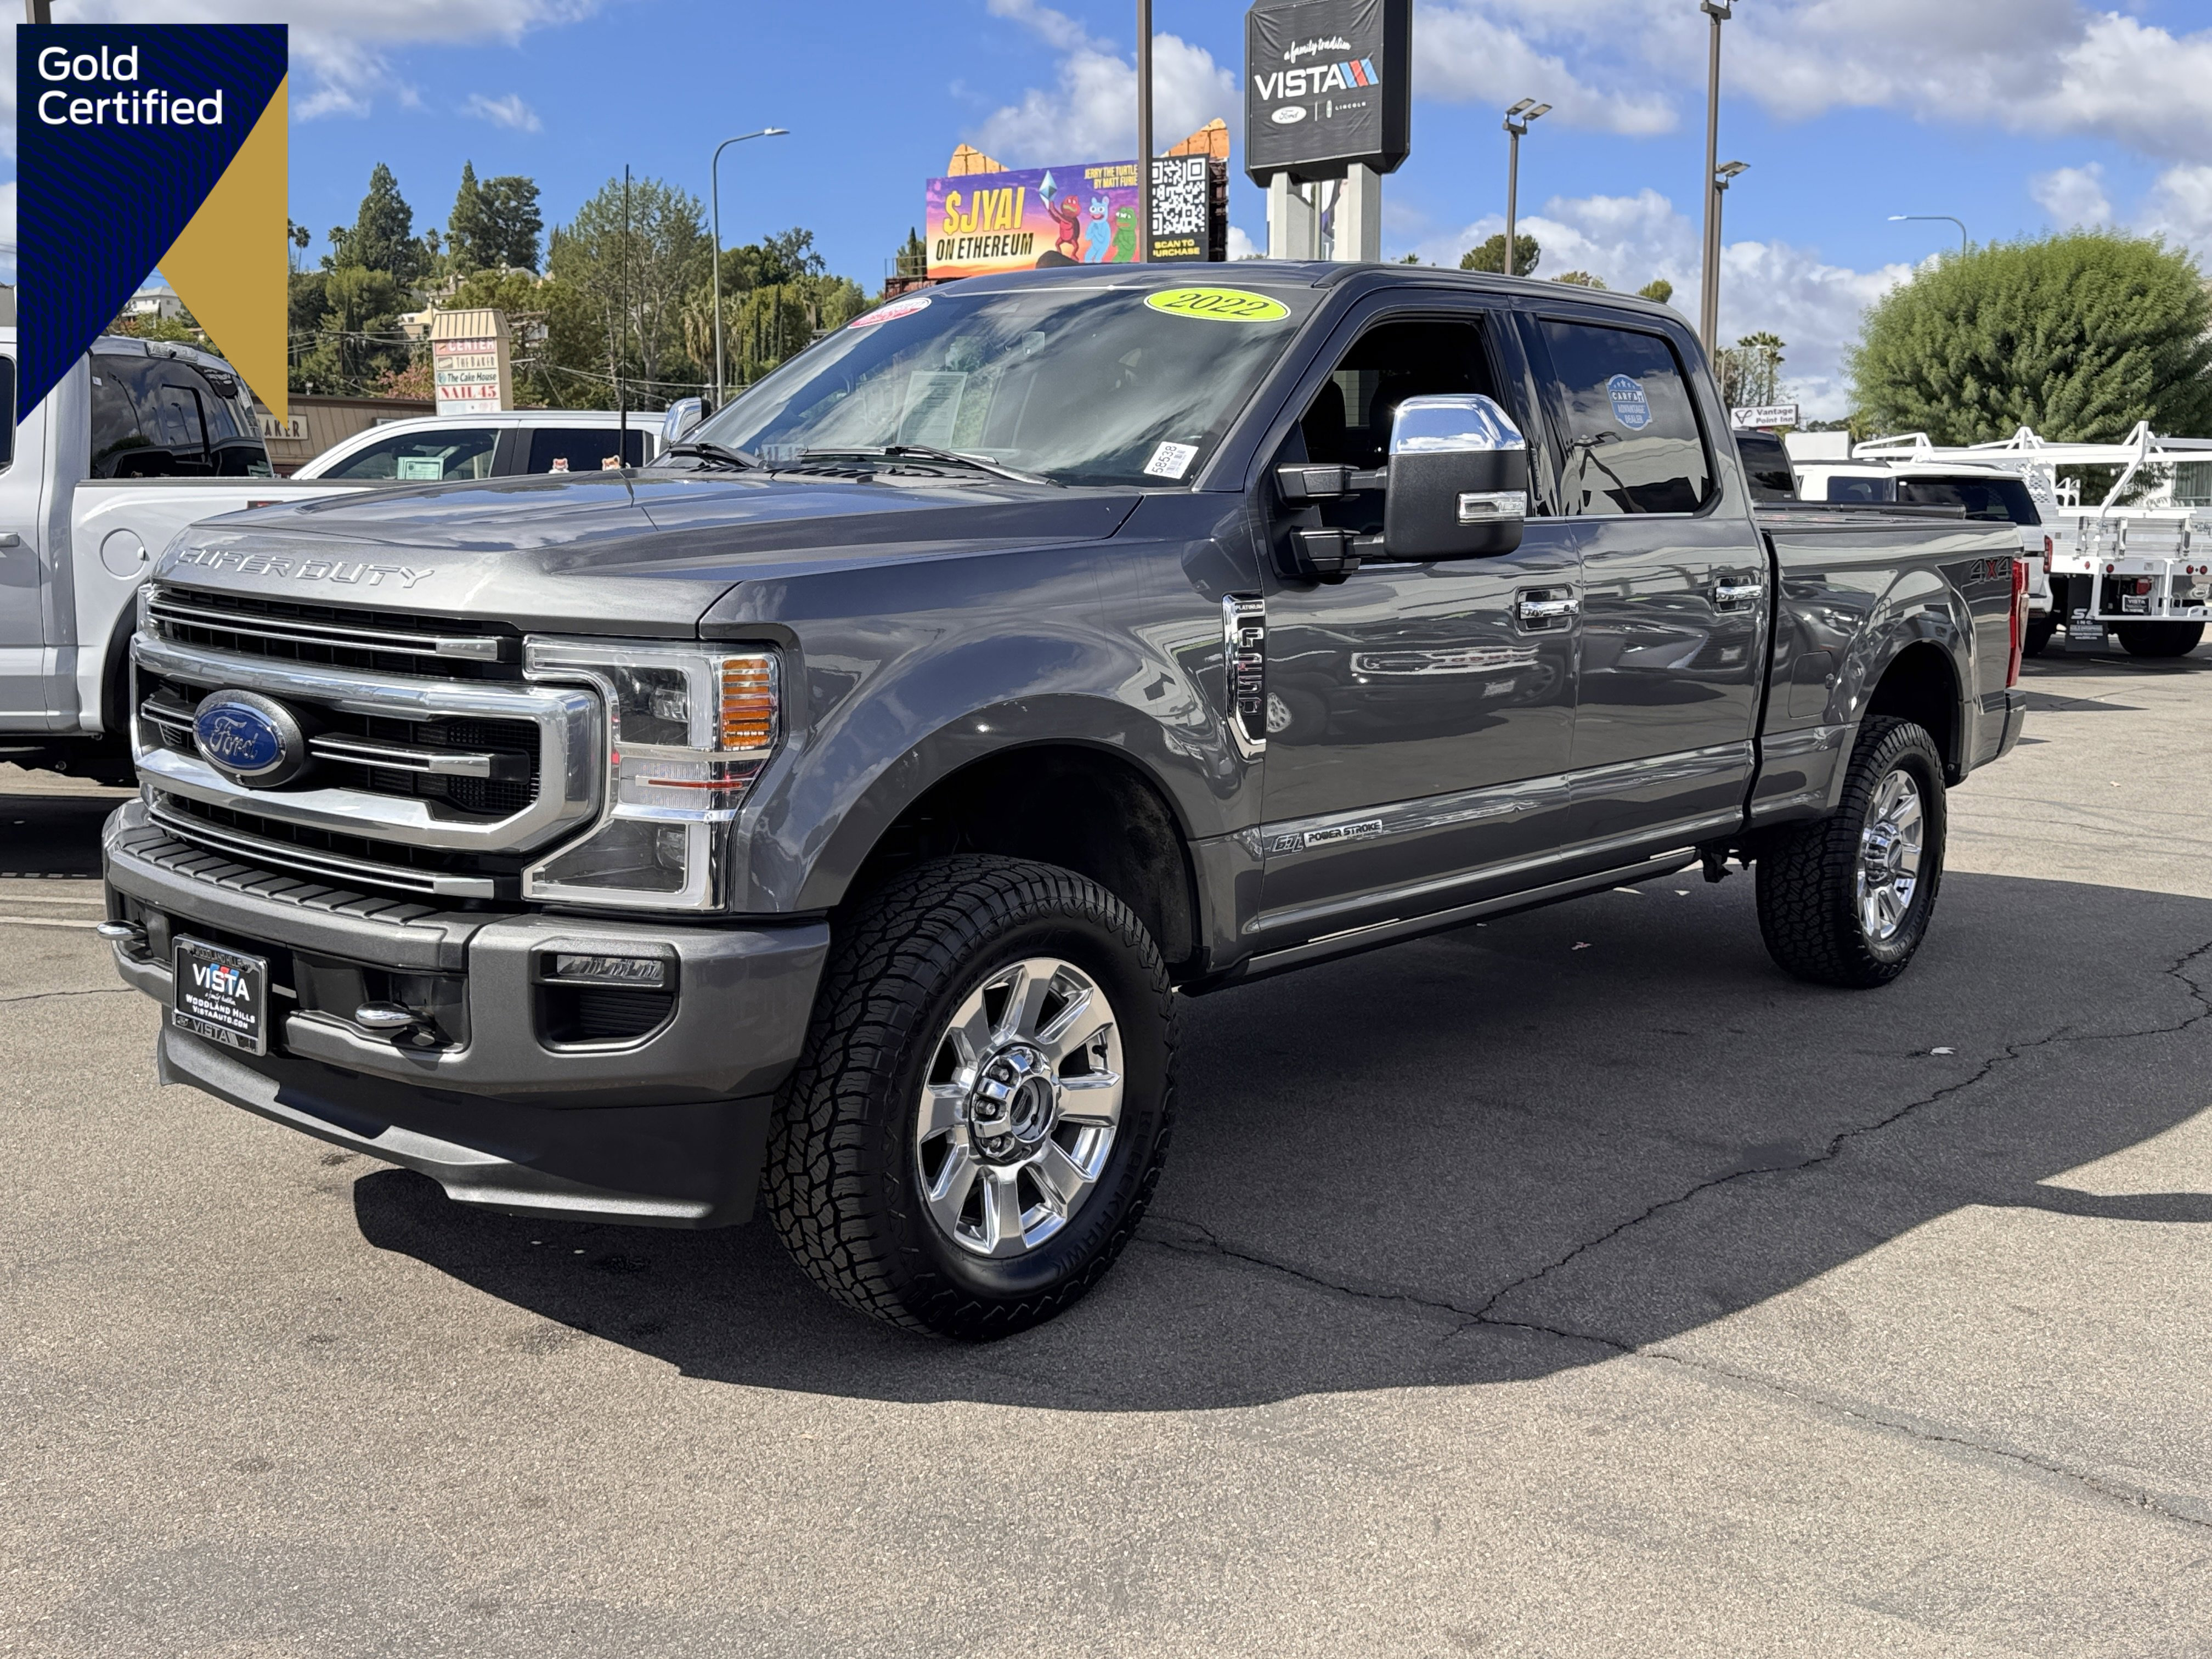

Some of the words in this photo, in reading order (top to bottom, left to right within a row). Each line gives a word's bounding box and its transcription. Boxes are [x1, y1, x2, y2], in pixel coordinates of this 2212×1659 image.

[1254, 63, 1347, 101] VISTA
[1279, 110, 1298, 120] Ford
[1335, 101, 1367, 111] LINCOLN
[1084, 167, 1102, 179] JERRY
[1103, 166, 1115, 177] THE
[1115, 164, 1138, 176] TURTLE
[1093, 179, 1102, 189] BY
[1102, 177, 1120, 188] MATT
[1120, 176, 1138, 187] FURIE
[943, 187, 1026, 236] $JYAI
[935, 238, 955, 261] ON
[957, 232, 1034, 259] ETHEREUM
[1154, 240, 1181, 249] SCAN
[1181, 239, 1195, 247] TO
[1163, 293, 1270, 316] 2022
[448, 338, 495, 352] CENTER
[456, 357, 469, 368] THE
[447, 373, 459, 382] The
[460, 372, 475, 382] Cake
[476, 372, 497, 381] House
[478, 385, 497, 398] 45
[1612, 391, 1645, 403] CARFAX
[1151, 445, 1177, 473] 58538
[174, 548, 295, 578] SUPER
[295, 559, 435, 589] DUTY
[209, 715, 259, 760] Ford
[1308, 828, 1342, 843] POWER
[1343, 821, 1381, 836] STROKE
[192, 963, 251, 1001] VISTA
[185, 993, 231, 1015] WOODLAND
[232, 1008, 256, 1024] HILLS
[192, 1018, 229, 1043] VISTA
